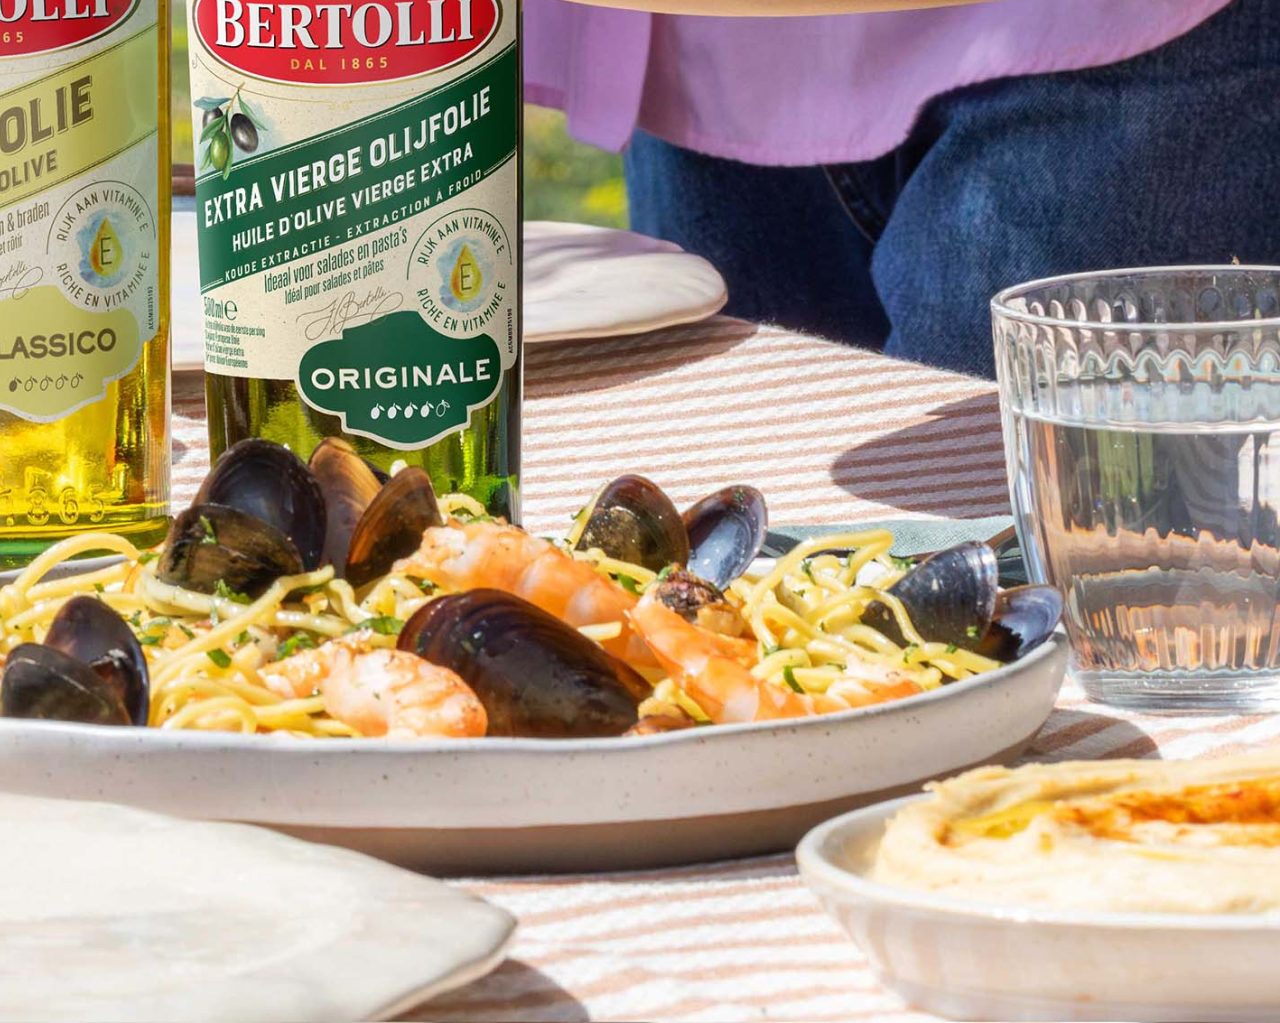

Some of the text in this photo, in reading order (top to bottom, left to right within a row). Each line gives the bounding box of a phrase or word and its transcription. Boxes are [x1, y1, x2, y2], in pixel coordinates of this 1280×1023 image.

[291, 56, 388, 71] DAL 1865
[204, 85, 491, 228] EXTRA VIERGE OLIJFOLIE
[7, 212, 15, 232] &
[17, 201, 50, 228] braden
[56, 212, 76, 242] RIJK
[75, 192, 99, 215] AAN
[102, 189, 145, 222] VITAMINE
[232, 142, 473, 252] HUILE D'OLIVE VIERGE EXTRA
[225, 260, 257, 282] KOUDE
[261, 235, 331, 268] EXTRACTIE
[347, 195, 430, 239] EXTRACTION
[448, 169, 482, 195] FROID
[417, 237, 438, 265] RIJK
[437, 219, 460, 241] AAN
[462, 216, 501, 246] VITAMINE
[100, 236, 113, 265] E
[264, 226, 408, 294] Ideaal voor salades en pasta's
[56, 263, 84, 299] RICHE
[84, 292, 100, 307] EN
[104, 262, 148, 308] VITAMINE
[284, 285, 304, 305] Idéal
[304, 282, 320, 301] pour
[322, 271, 352, 293] salades
[353, 267, 362, 280] et
[460, 263, 472, 291] E
[417, 288, 443, 323] RICHE
[443, 316, 458, 332] EN
[462, 293, 504, 333] VITAMINE
[310, 358, 491, 392] ORIGINALE
